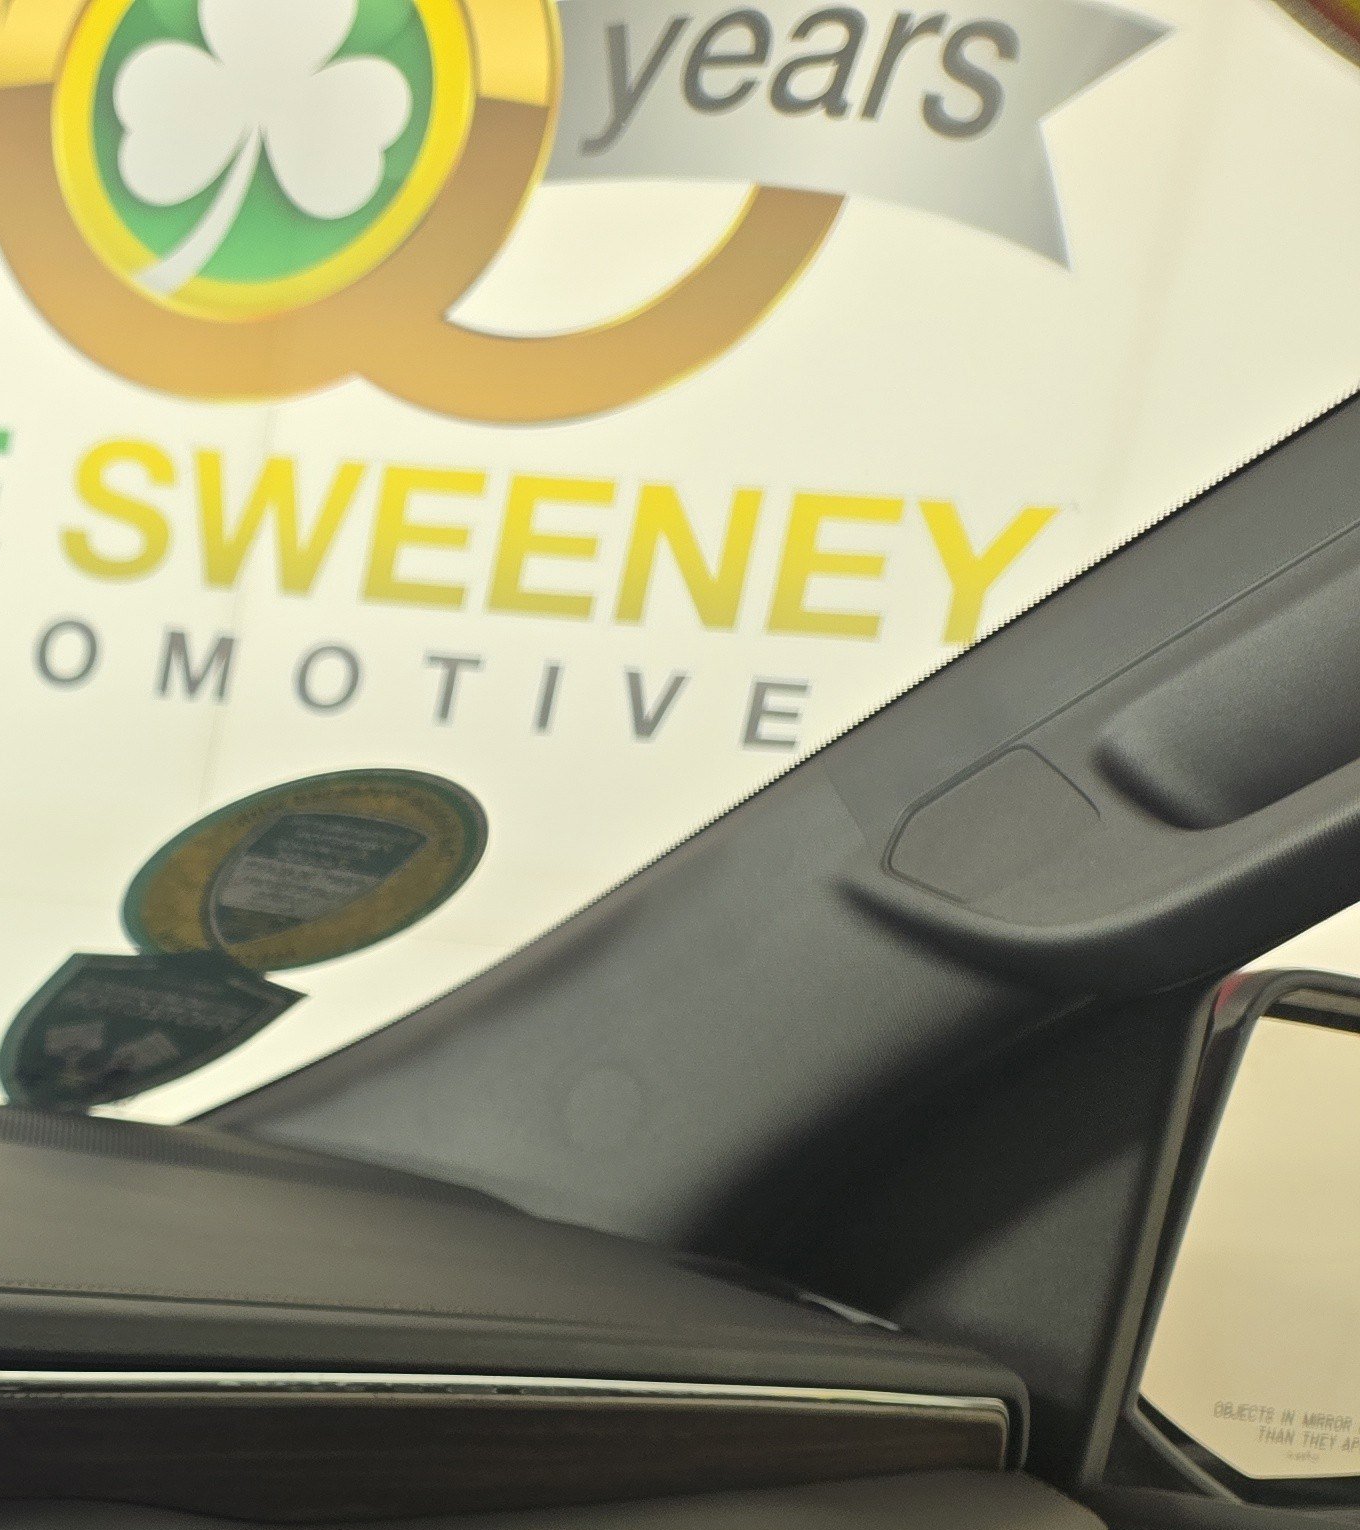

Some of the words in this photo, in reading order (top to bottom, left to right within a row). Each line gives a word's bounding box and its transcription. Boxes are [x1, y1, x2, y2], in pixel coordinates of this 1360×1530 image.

[577, 1, 1021, 159] years
[57, 435, 1062, 647] SWEENEY
[1214, 1400, 1275, 1424] OBJECTS
[1280, 1409, 1295, 1426] IN
[1302, 1411, 1353, 1432] MIRROR
[1258, 1426, 1295, 1445] THAN
[1302, 1431, 1338, 1450] THEY
